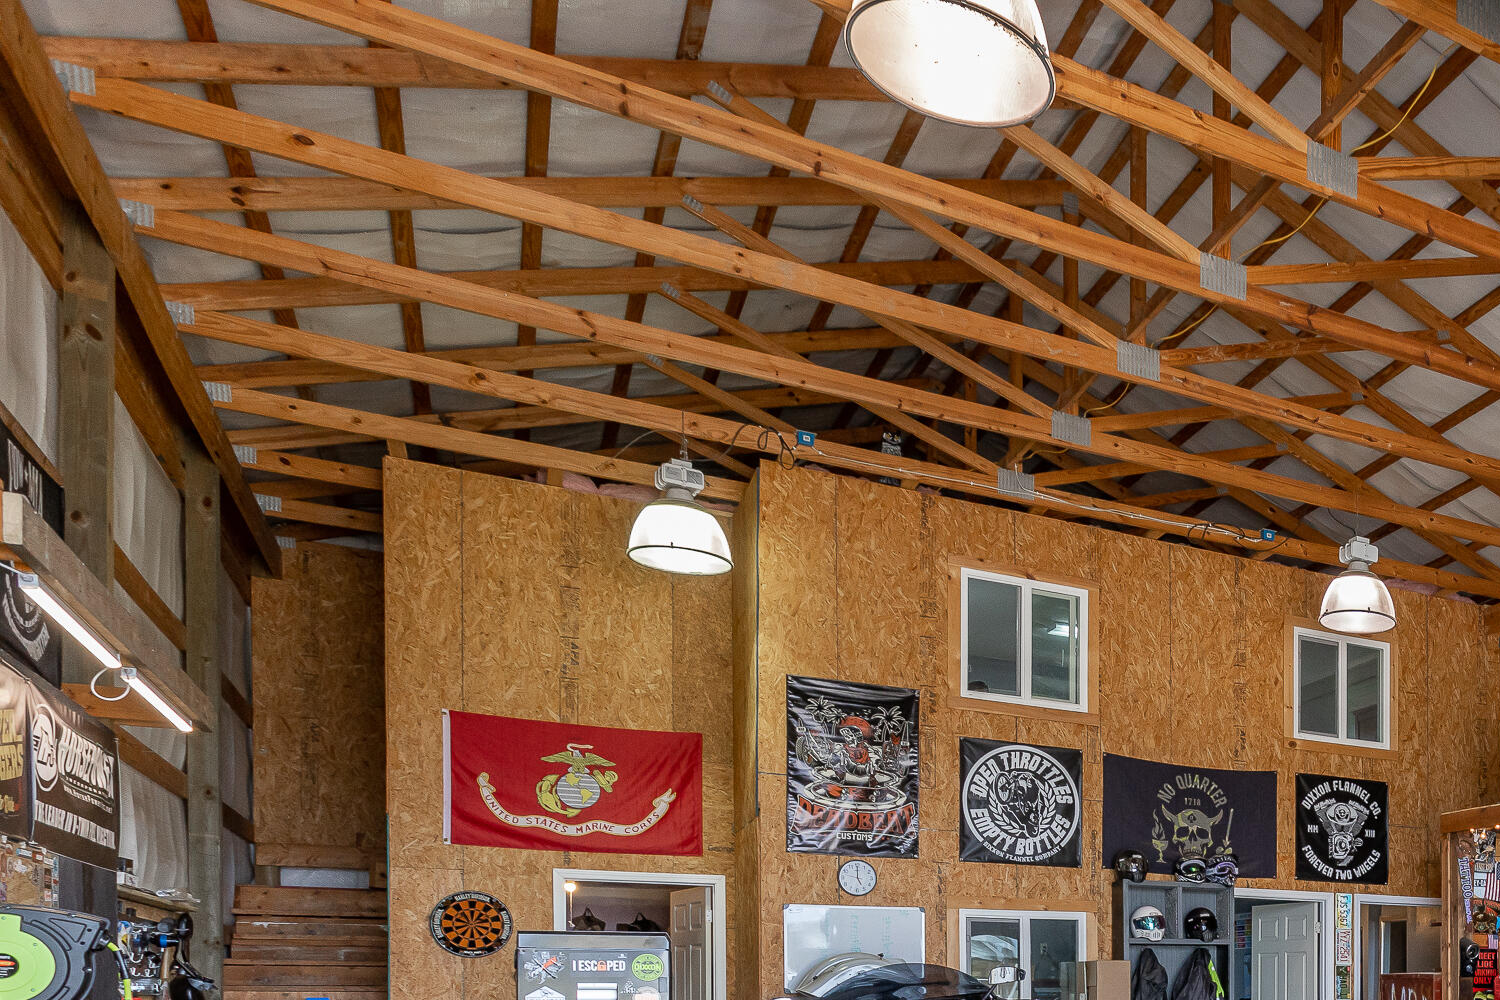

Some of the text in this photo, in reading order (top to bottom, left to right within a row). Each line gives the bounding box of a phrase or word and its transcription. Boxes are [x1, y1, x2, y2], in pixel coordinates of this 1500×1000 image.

[970, 751, 1073, 804] OPEN THROTTLES
[1157, 773, 1227, 808] NO QUARTER
[485, 794, 660, 834] UNITED STATES MARINE CORPS
[1301, 780, 1381, 819] DIXXON FLANNEL CO.
[836, 832, 873, 841] CUSTOMS
[970, 808, 1071, 856] EMPTY BOTTLES
[1006, 852, 1034, 862] FLANNEL
[1035, 846, 1061, 861] COMPANY
[1301, 844, 1381, 880] FOREVER TWO WHEELS
[1458, 857, 1473, 898] TATTOO
